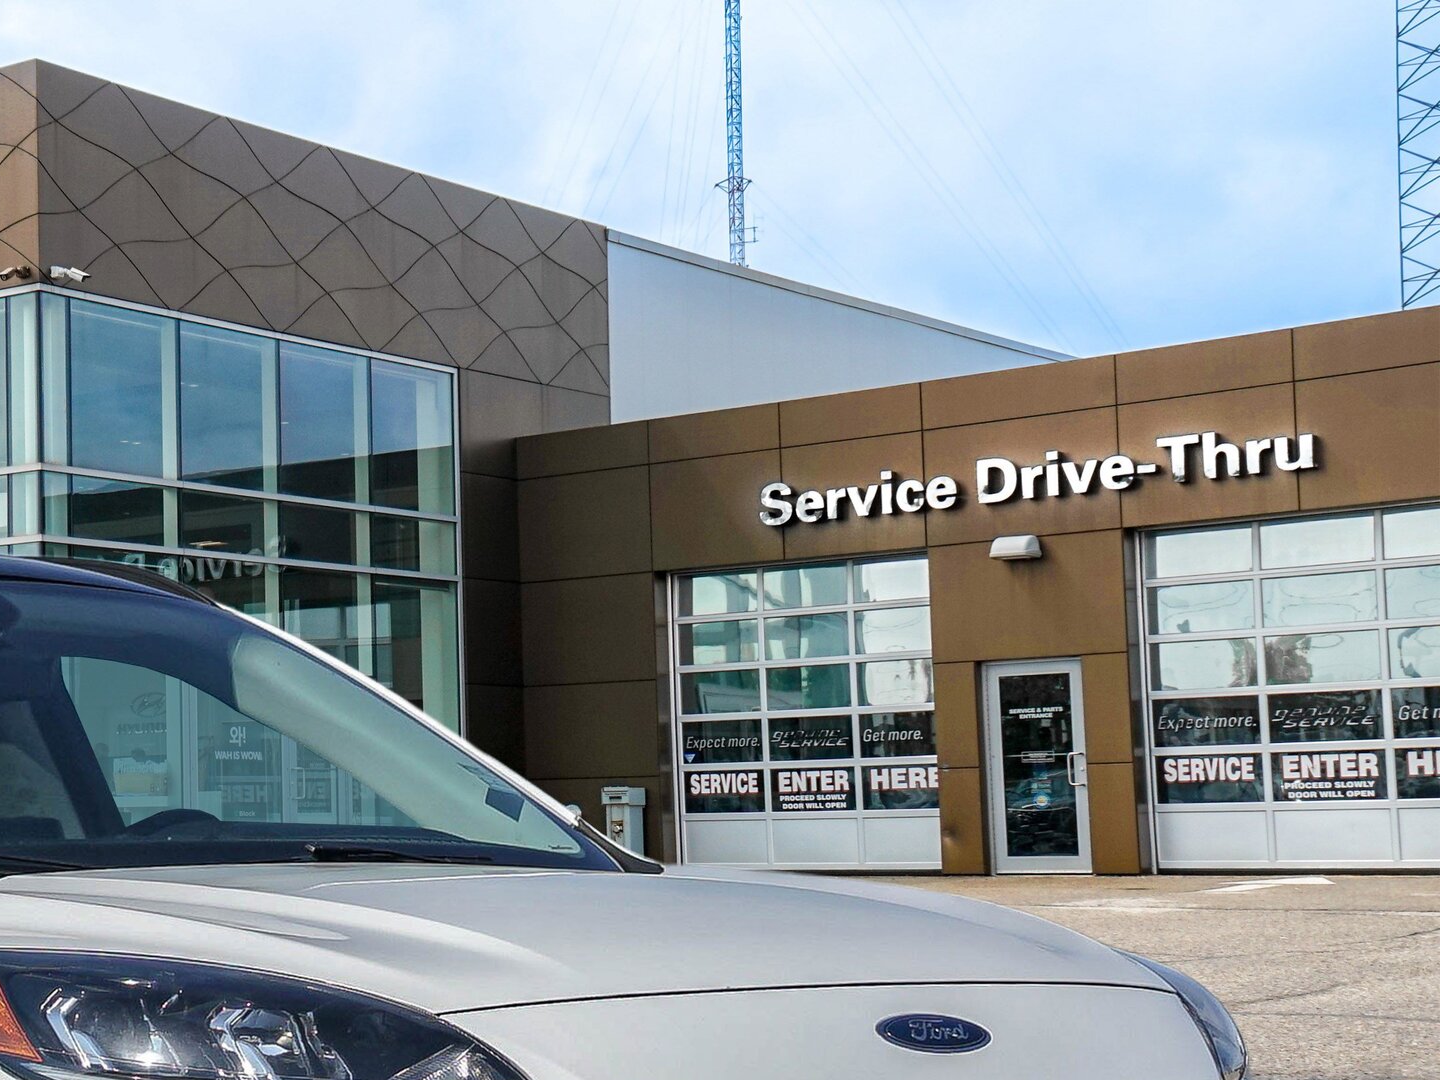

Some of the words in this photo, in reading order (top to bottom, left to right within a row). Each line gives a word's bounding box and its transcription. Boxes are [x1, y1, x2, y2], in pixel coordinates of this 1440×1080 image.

[759, 470, 958, 527] Service
[976, 430, 1318, 504] Drive-Thru
[1009, 707, 1036, 715] SERVICE
[1019, 712, 1054, 720] ENTRANCE
[1271, 704, 1368, 723] genuine
[1398, 705, 1430, 721] Get
[1158, 715, 1211, 733] Expect
[1213, 714, 1257, 729] more.
[1282, 714, 1376, 729] SERVICE
[687, 737, 727, 750] Expect
[727, 736, 761, 748] more.
[779, 737, 850, 748] SERVICE
[863, 728, 887, 743] Get
[888, 728, 924, 741] more.
[214, 750, 233, 760] WAH
[233, 751, 240, 760] IS
[1163, 755, 1256, 783] SERVICE
[1281, 752, 1380, 780] ENTER
[690, 772, 760, 795] SERVICE
[777, 769, 851, 793] ENTER
[1284, 781, 1332, 790] PROCEED
[1334, 780, 1376, 789] SLOWLY
[779, 794, 816, 802] PROCEED
[816, 793, 847, 801] SLOWLY
[1287, 790, 1318, 799] DOOR
[1318, 790, 1344, 798] WILL
[1346, 789, 1376, 798] OPEN
[782, 802, 802, 810] DOOR
[825, 801, 847, 810] OPEN
[907, 1019, 969, 1041] Ford
